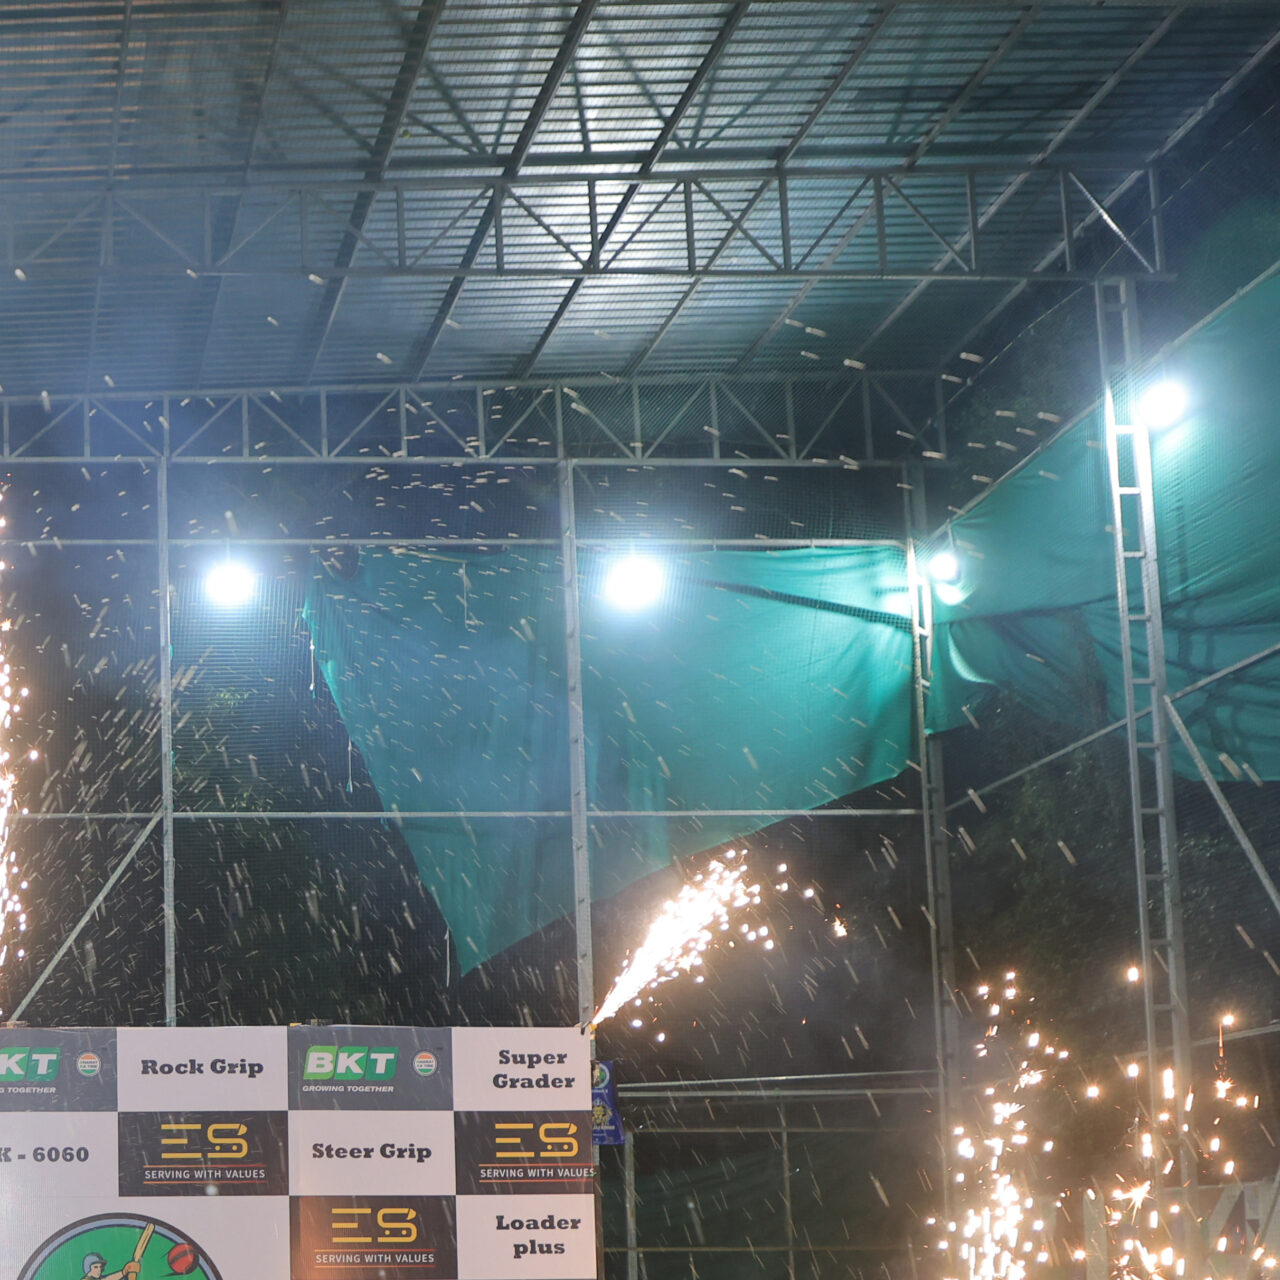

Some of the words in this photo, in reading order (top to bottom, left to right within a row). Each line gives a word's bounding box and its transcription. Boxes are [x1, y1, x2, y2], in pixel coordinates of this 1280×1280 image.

[305, 1051, 396, 1075] BKT
[498, 1049, 568, 1068] Super
[141, 1059, 205, 1075] Rock
[210, 1059, 264, 1078] Grip
[8, 1086, 56, 1094] TOGETHER
[303, 1085, 345, 1093] GROWING
[347, 1085, 394, 1093] TOGETHER
[493, 1074, 575, 1089] Grader
[161, 1122, 248, 1159] ES
[495, 1122, 578, 1158] ES
[32, 1146, 90, 1162] 6060
[312, 1143, 374, 1159] Steer
[379, 1143, 432, 1162] Grip
[144, 1169, 192, 1180] SERVING
[194, 1169, 222, 1180] WITH
[225, 1169, 265, 1180] VALUES
[480, 1168, 527, 1179] SERVING
[530, 1168, 558, 1179] WITH
[560, 1168, 595, 1179] VALUES
[331, 1208, 417, 1243] ES
[496, 1214, 581, 1231] Loader
[514, 1239, 565, 1259] plus
[315, 1253, 361, 1264] SERVING
[364, 1253, 393, 1264] WITH
[395, 1253, 435, 1264] VALUES
